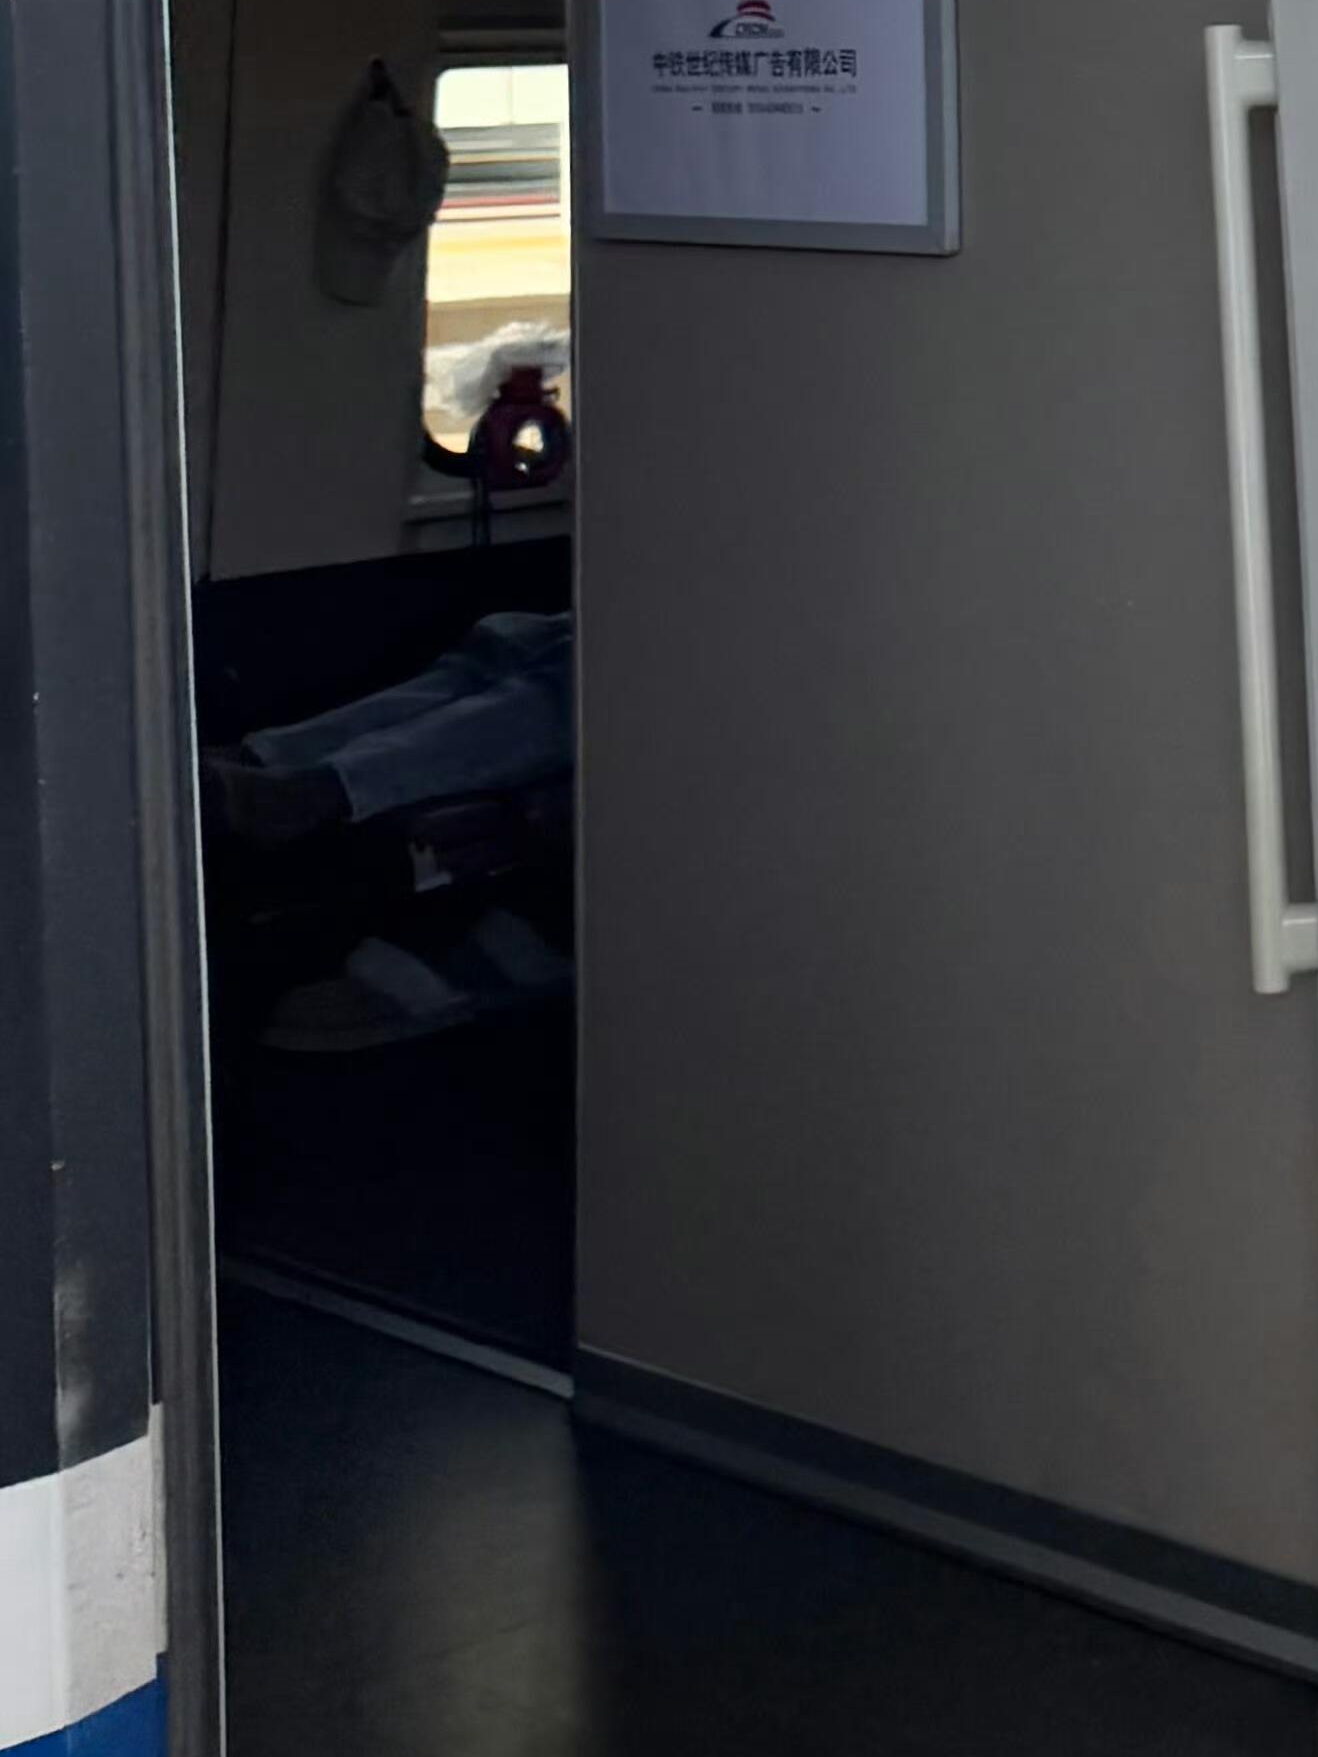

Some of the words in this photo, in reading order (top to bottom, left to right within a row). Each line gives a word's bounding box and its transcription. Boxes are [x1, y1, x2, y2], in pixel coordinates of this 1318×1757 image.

[652, 47, 857, 77] 中铁世纪传媒广告有限公司
